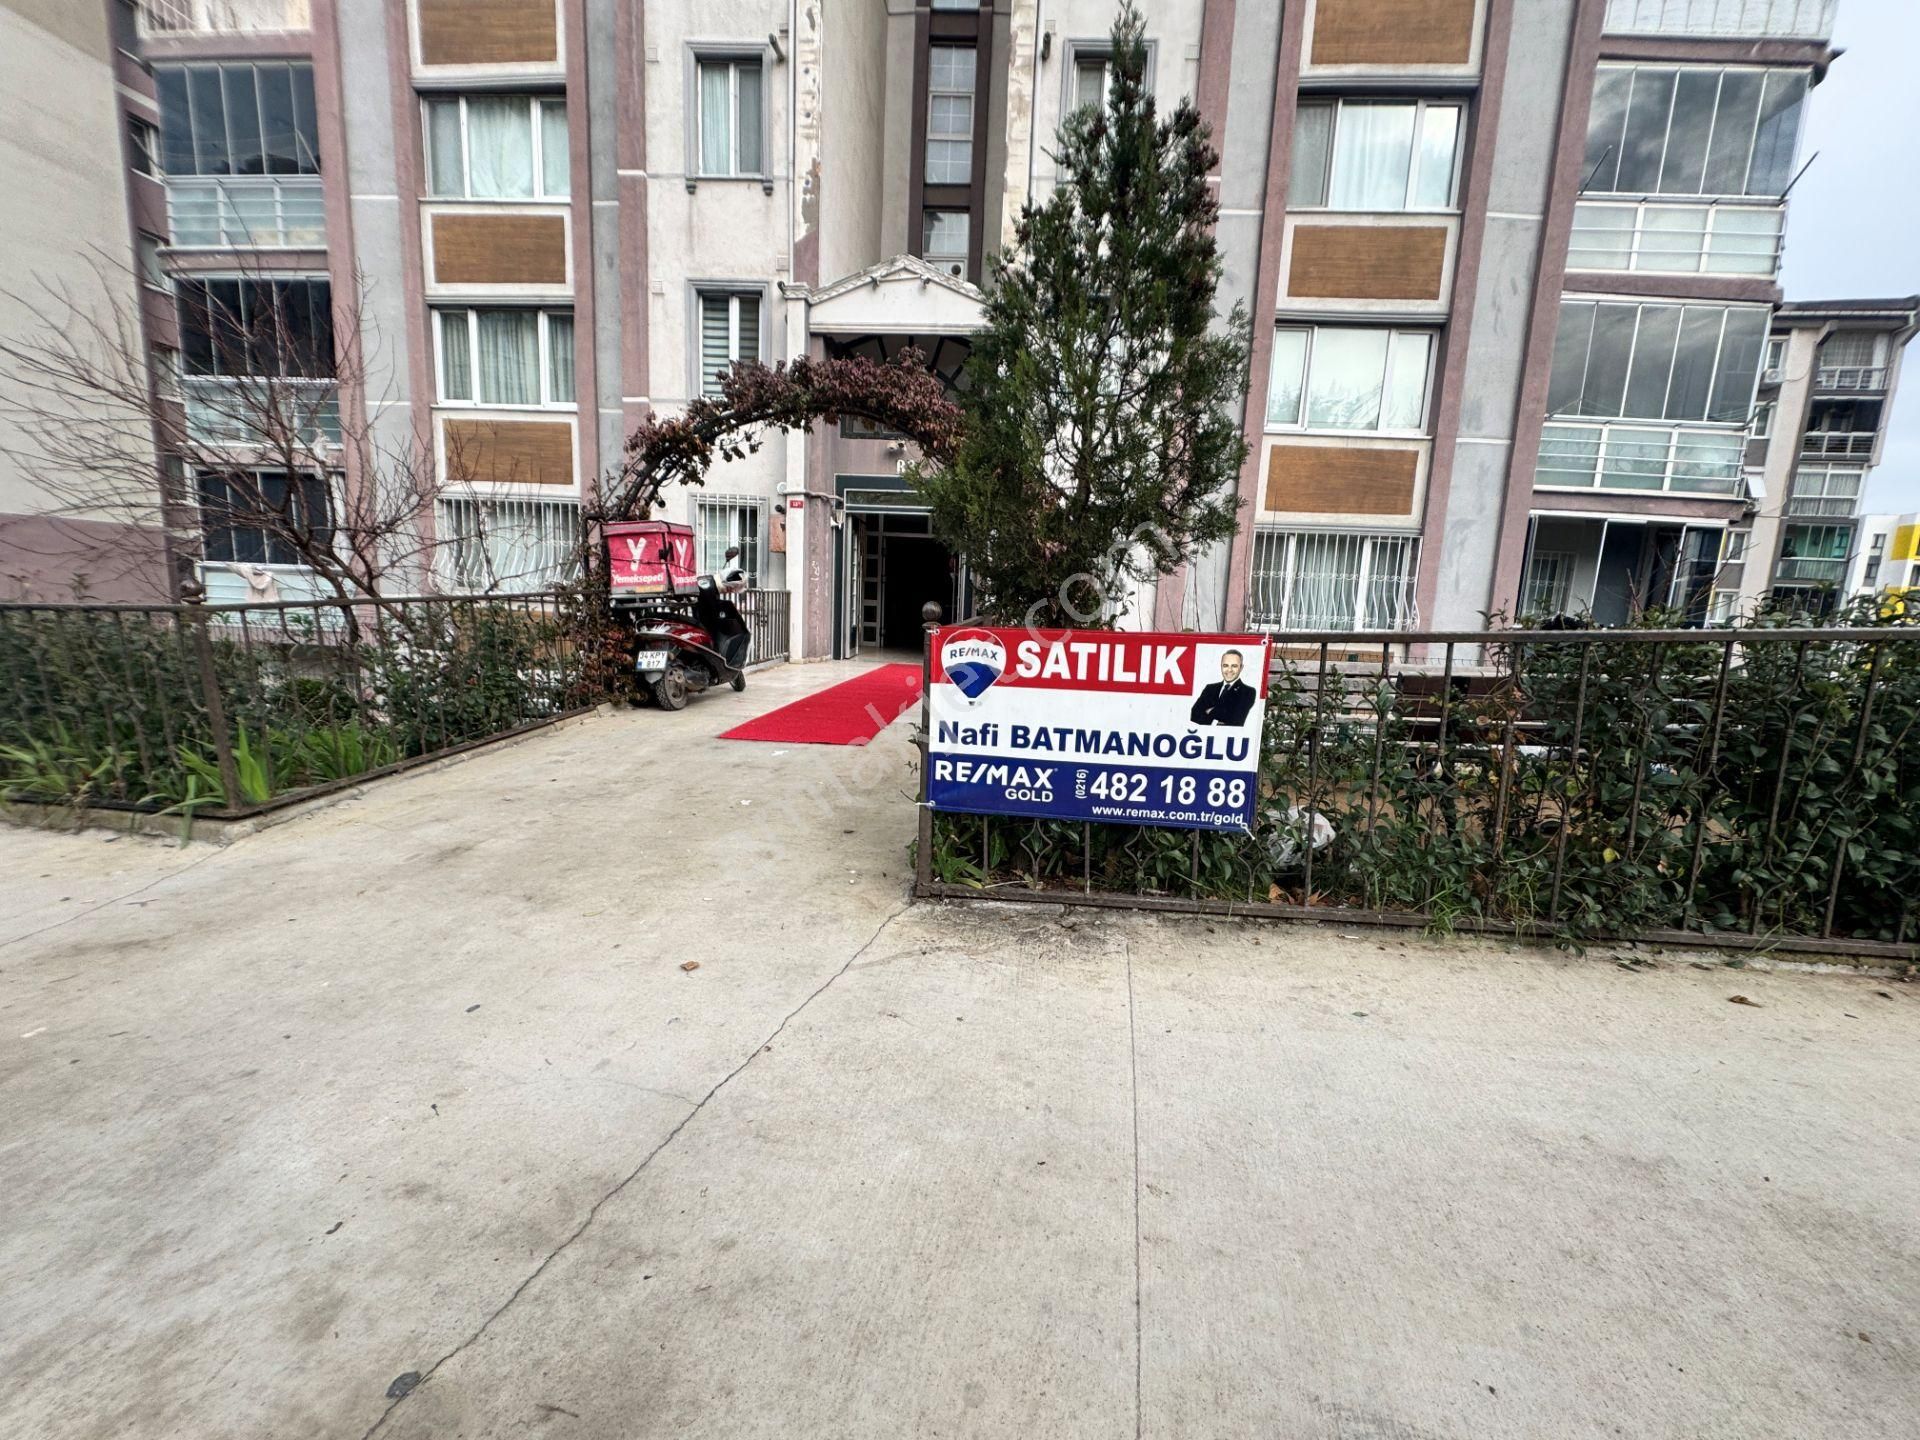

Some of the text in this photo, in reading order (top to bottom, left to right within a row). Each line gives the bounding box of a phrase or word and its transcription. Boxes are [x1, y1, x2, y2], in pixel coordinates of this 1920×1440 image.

[613, 574, 664, 584] Yemeksepeti
[950, 647, 998, 661] RE/MAX
[1016, 640, 1188, 685] SATILIK
[938, 720, 1250, 762] Nafi BATMANOĞLU
[935, 760, 1054, 789] RE/MAX
[1005, 788, 1053, 802] GOLD
[1075, 769, 1246, 808] (0216) 482 18 88
[1092, 805, 1244, 825] www.remax.com.tr/gold
